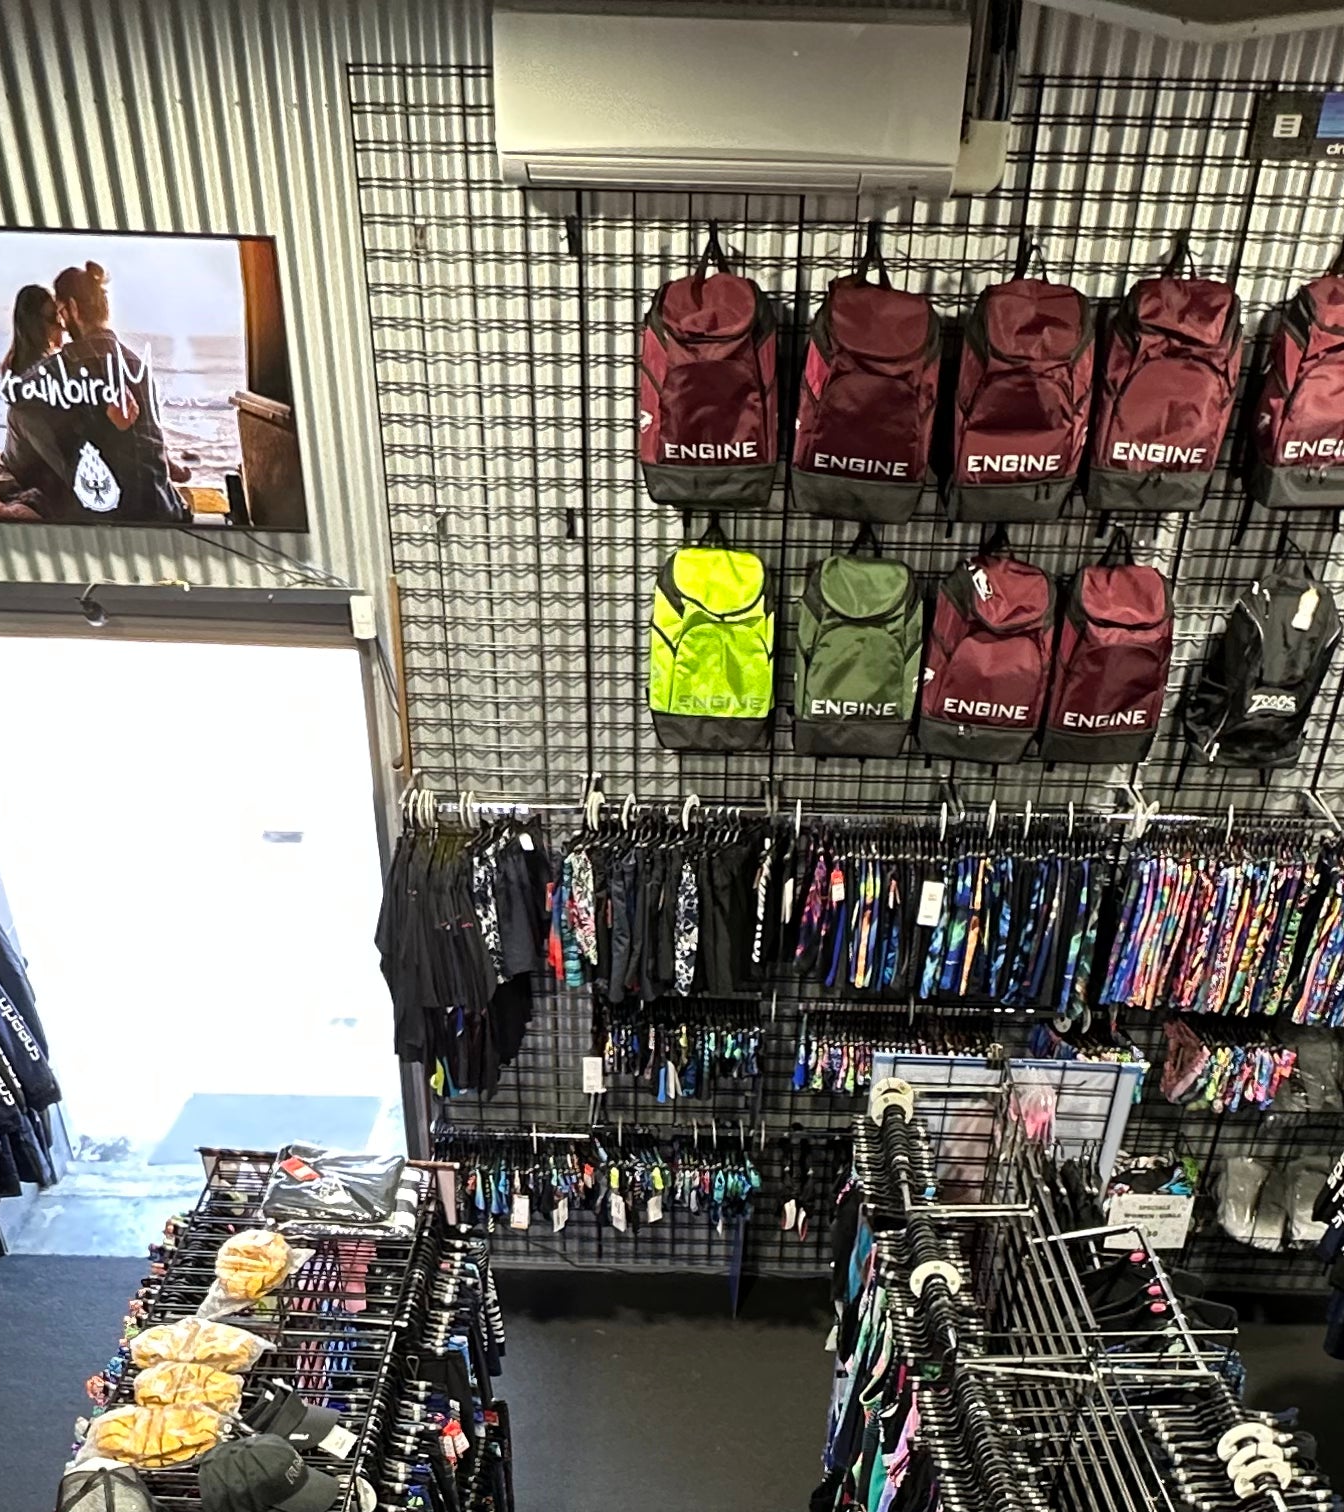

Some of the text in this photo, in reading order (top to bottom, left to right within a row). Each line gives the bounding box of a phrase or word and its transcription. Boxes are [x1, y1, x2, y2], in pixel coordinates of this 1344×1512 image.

[665, 442, 757, 459] ENGINE
[1112, 441, 1207, 463] ENGINE
[813, 453, 909, 477] ENGINE
[967, 454, 1061, 473] ENGINE
[680, 694, 765, 712] ENGINE
[811, 699, 898, 717] ENGINE
[943, 697, 1029, 720] ENGINE
[1063, 709, 1148, 729] ENGINE
